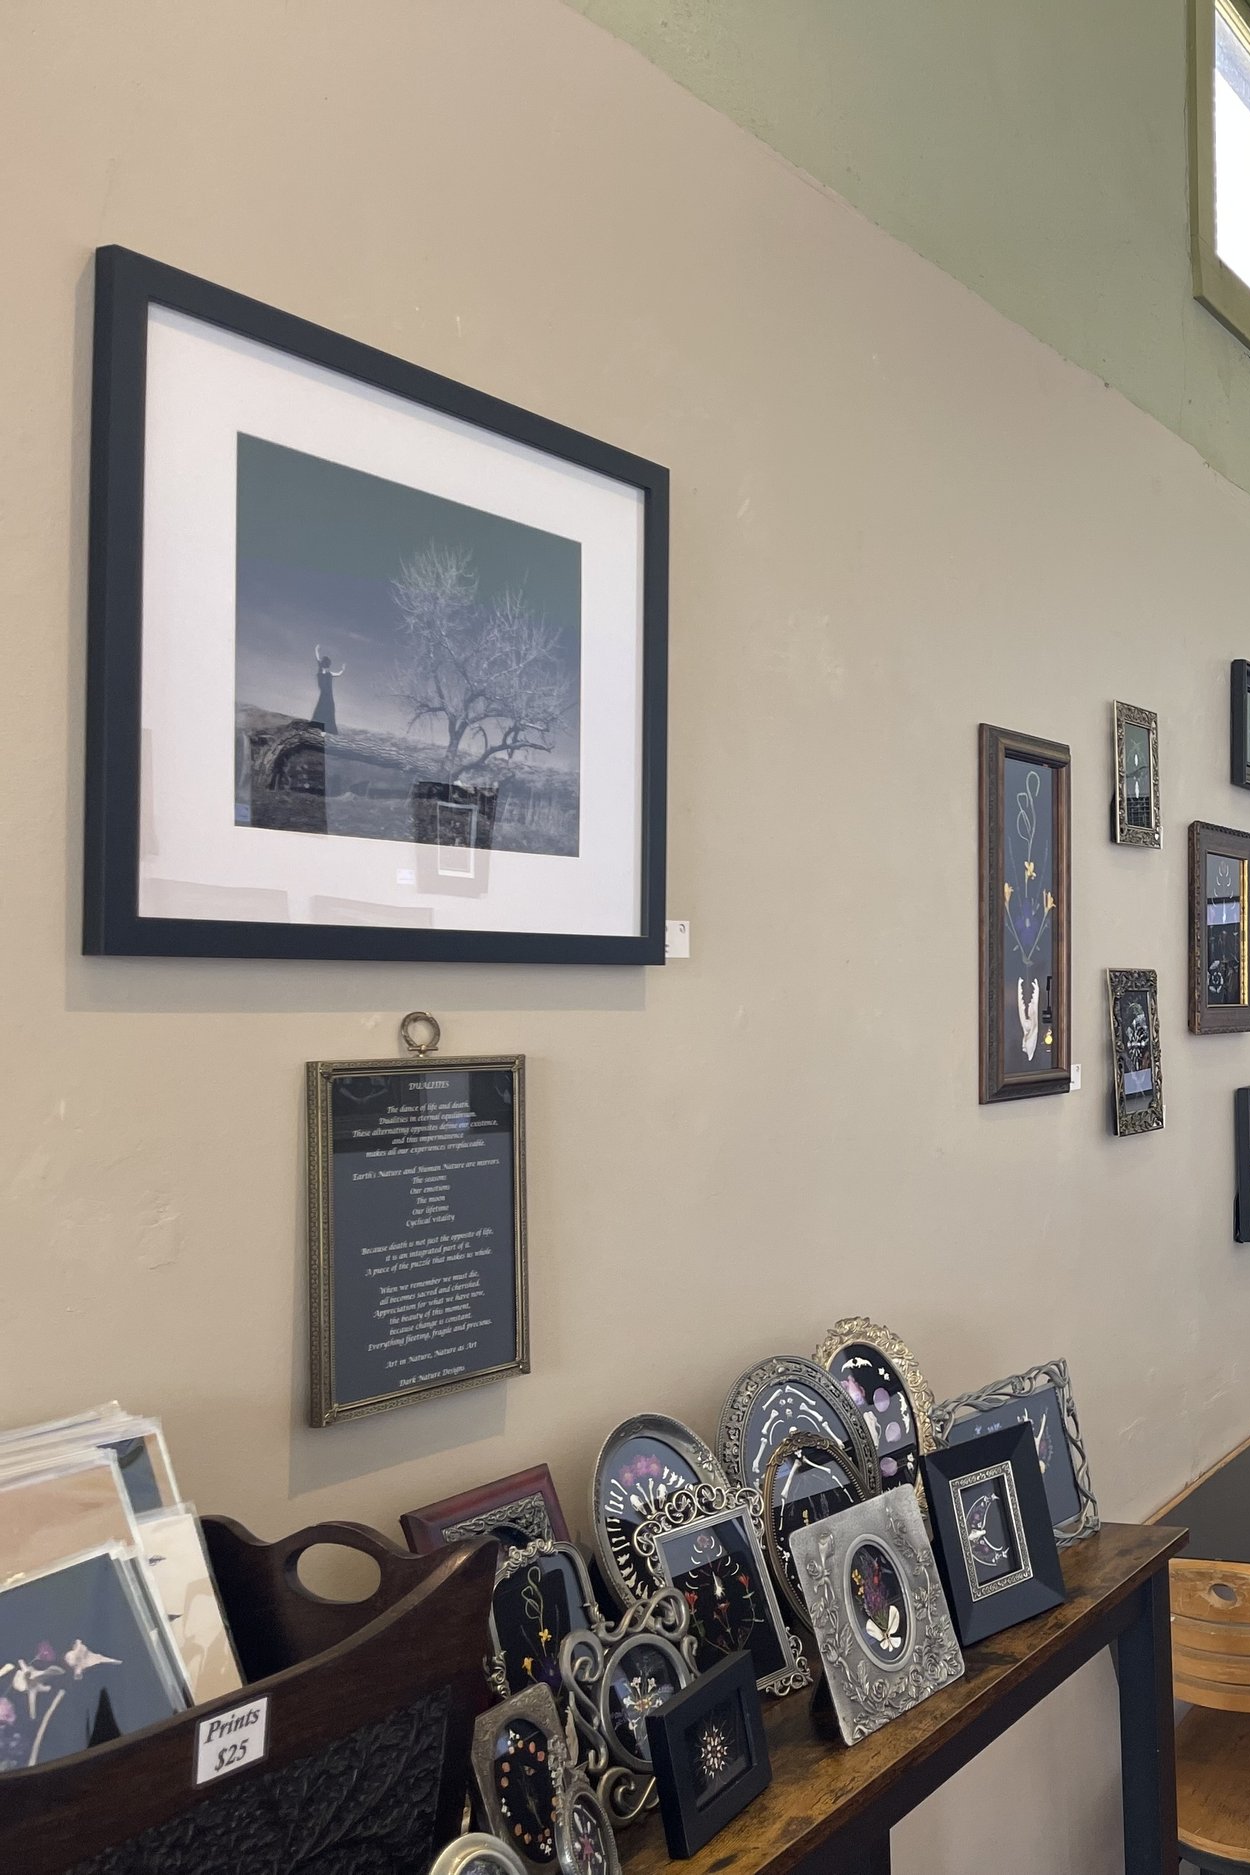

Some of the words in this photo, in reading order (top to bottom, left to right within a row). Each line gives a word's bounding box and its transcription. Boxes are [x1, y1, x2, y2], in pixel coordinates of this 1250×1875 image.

[387, 1106, 399, 1114] The
[400, 1104, 418, 1112] dance
[427, 1103, 437, 1112] life
[438, 1102, 450, 1110] and
[418, 1113, 440, 1121] eternal
[352, 1129, 370, 1138] These
[372, 1127, 410, 1136] alternating
[410, 1124, 438, 1134] opposites
[392, 1136, 405, 1145] and
[406, 1135, 418, 1143] this
[419, 1132, 463, 1143] impermanence
[366, 1149, 386, 1158] makes
[387, 1147, 396, 1156] all
[410, 1145, 446, 1156] experiences
[352, 1171, 376, 1181] Earth's
[378, 1169, 402, 1178] Nature
[403, 1166, 417, 1175] and
[417, 1165, 442, 1173] Human
[424, 1175, 447, 1183] seasons
[423, 1185, 451, 1193] emotions
[426, 1205, 449, 1215] lifetime
[406, 1218, 431, 1228] Cyclical
[432, 1214, 455, 1222] vitality
[361, 1247, 388, 1255] Because
[388, 1241, 408, 1250] death
[426, 1236, 438, 1246] just
[440, 1234, 450, 1242] the
[450, 1231, 475, 1242] opposite
[409, 1246, 441, 1258] integrated
[442, 1244, 456, 1252] part
[372, 1267, 390, 1277] piece
[398, 1262, 409, 1270] the
[410, 1258, 431, 1270] puzzle
[432, 1256, 445, 1264] that
[446, 1252, 465, 1261] makes
[380, 1286, 398, 1295] When
[410, 1277, 442, 1289] remember
[452, 1272, 468, 1281] must
[380, 1297, 389, 1306] all
[390, 1294, 416, 1304] becomes
[417, 1288, 438, 1298] sacred
[438, 1285, 452, 1294] and
[373, 1304, 416, 1319] Appreciation
[417, 1302, 427, 1310] for
[428, 1297, 444, 1306] what
[454, 1293, 470, 1301] have
[390, 1317, 400, 1325] the
[401, 1312, 423, 1322] beauty
[432, 1308, 443, 1316] this
[390, 1325, 414, 1336] because
[415, 1320, 438, 1330] change
[368, 1337, 405, 1352] Everything
[432, 1327, 453, 1338] fragile
[453, 1323, 466, 1332] and
[434, 1346, 456, 1356] Nature
[465, 1341, 478, 1350] Art
[400, 1375, 416, 1386] Dark
[418, 1370, 441, 1381] Nature
[442, 1365, 466, 1376] Designs
[203, 1708, 260, 1744] Prints
[215, 1737, 249, 1771] $25
